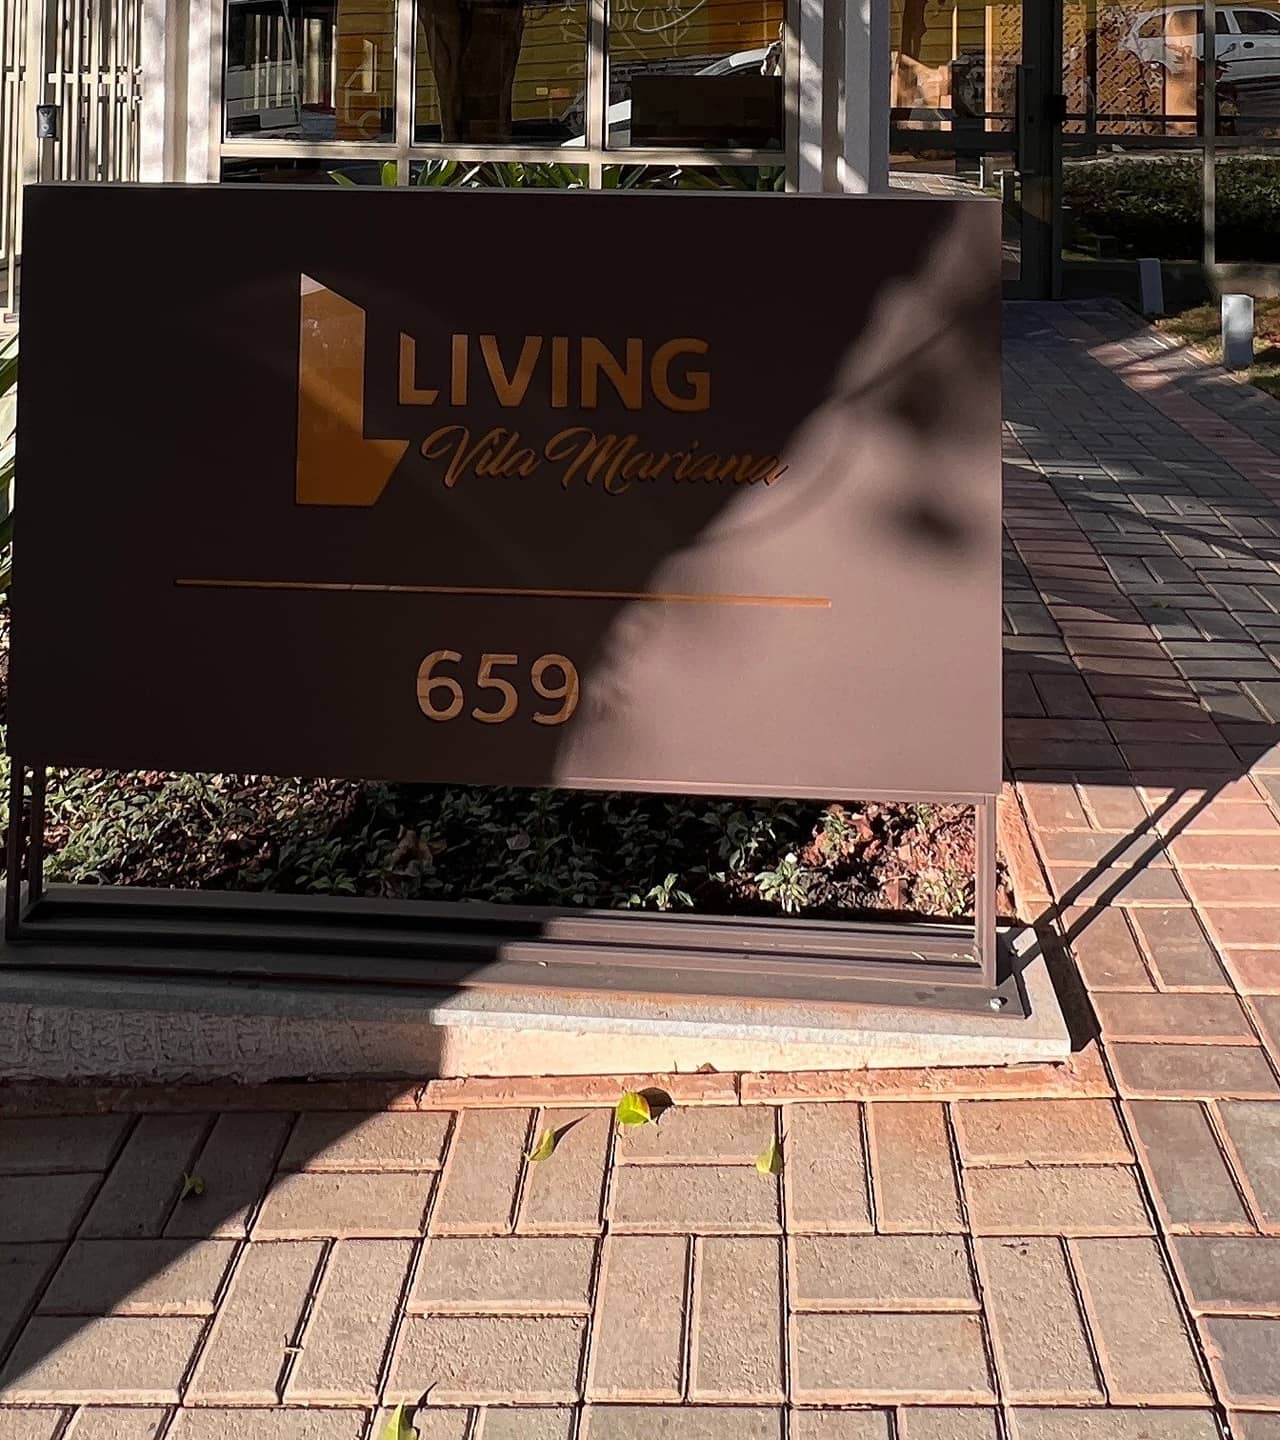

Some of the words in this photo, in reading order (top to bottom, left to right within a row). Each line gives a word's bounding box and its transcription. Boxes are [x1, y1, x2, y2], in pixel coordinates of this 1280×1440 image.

[398, 331, 712, 413] LIVING
[420, 424, 544, 489] Vila
[544, 426, 790, 496] Mariana
[416, 649, 579, 725] 659
